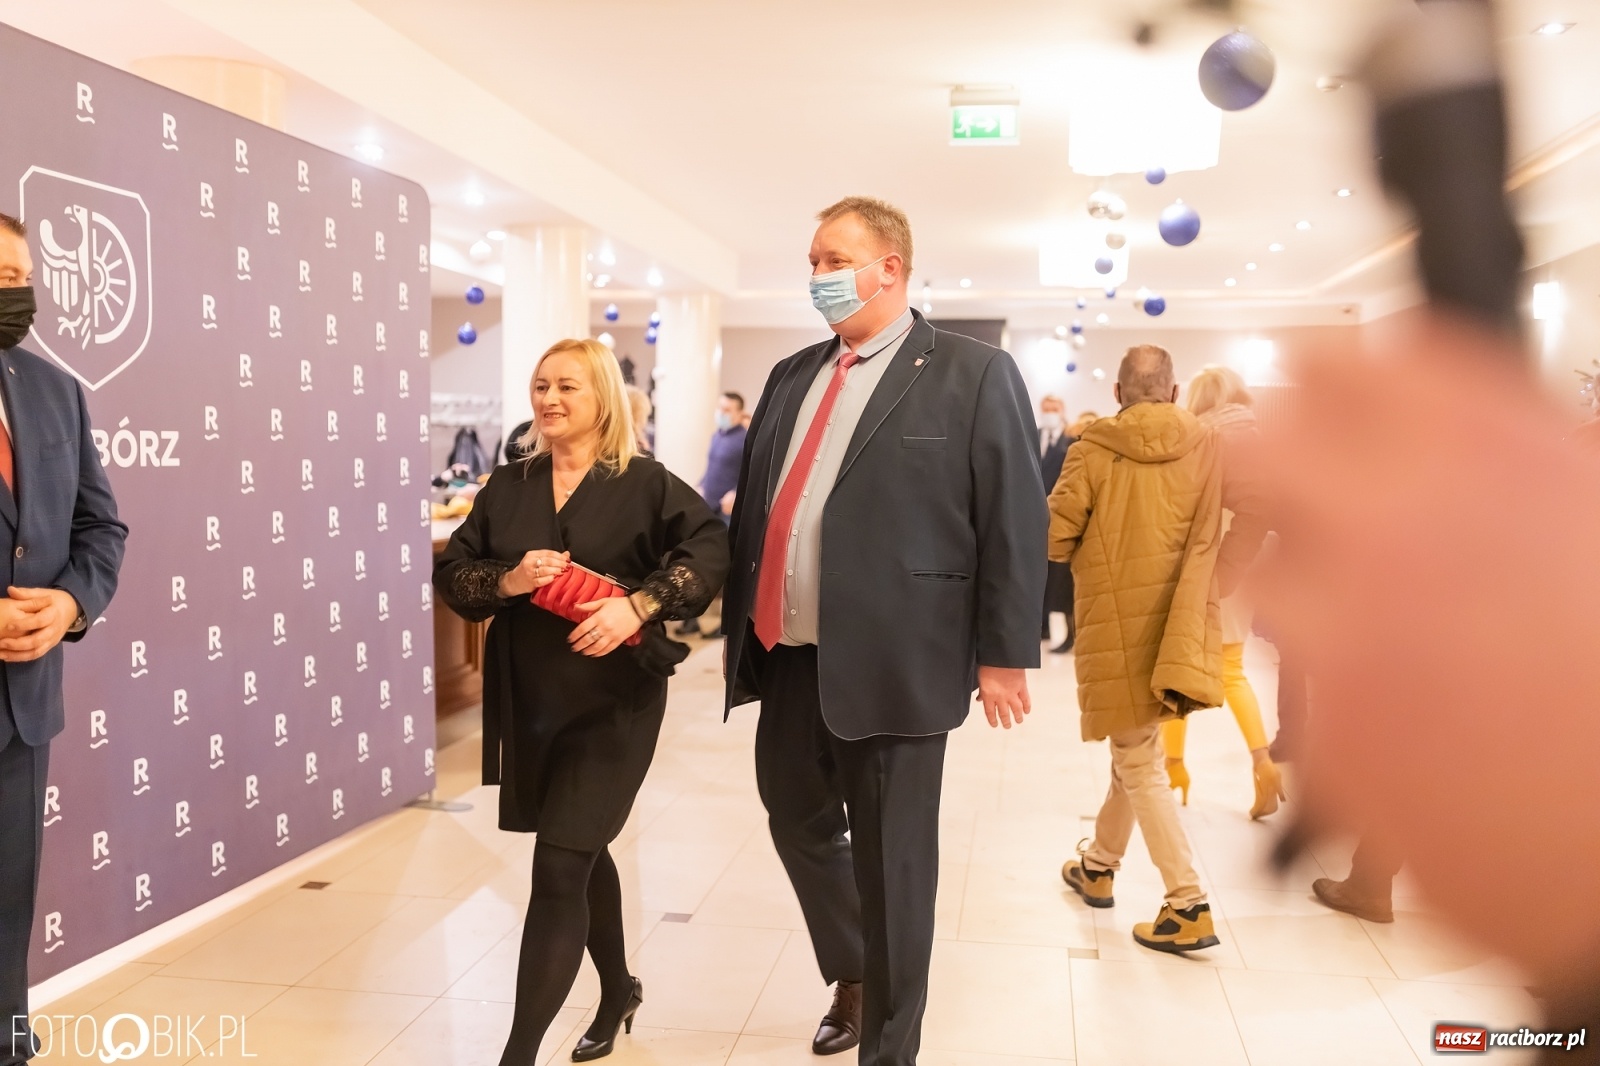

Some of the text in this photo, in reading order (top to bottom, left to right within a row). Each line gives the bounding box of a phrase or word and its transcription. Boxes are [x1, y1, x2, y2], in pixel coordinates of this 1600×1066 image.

[76, 81, 94, 114] R
[162, 112, 178, 142] R
[235, 138, 248, 165] R
[297, 159, 309, 185] R
[200, 181, 214, 210] R
[352, 178, 361, 201] R
[267, 201, 280, 227] R
[398, 195, 407, 215] R
[325, 217, 336, 241] R
[375, 231, 385, 253] R
[237, 246, 250, 272] R
[418, 244, 428, 266] R
[299, 260, 311, 284] R
[352, 271, 363, 294] R
[399, 282, 408, 303] R
[202, 294, 217, 321] R
[269, 305, 281, 330] R
[326, 314, 337, 337] R
[376, 322, 385, 344] R
[419, 330, 428, 350] R
[239, 353, 252, 379] R
[300, 359, 312, 383] R
[353, 364, 364, 387] R
[399, 370, 409, 391] R
[204, 405, 219, 431] R
[270, 408, 283, 432] R
[327, 410, 338, 433] R
[376, 412, 386, 434] R
[419, 414, 429, 435] R
[241, 460, 254, 485] R
[301, 458, 313, 482] R
[354, 457, 365, 480] R
[400, 457, 409, 478] R
[328, 506, 340, 529] R
[377, 502, 388, 524] R
[420, 498, 430, 520] R
[206, 515, 220, 541] R
[272, 510, 284, 535] R
[355, 550, 366, 573] R
[400, 543, 411, 565] R
[242, 565, 256, 591] R
[303, 557, 315, 581] R
[171, 575, 187, 602] R
[421, 582, 431, 604] R
[329, 601, 341, 624] R
[378, 591, 389, 613] R
[273, 612, 286, 637] R
[208, 625, 222, 651] R
[402, 629, 412, 651] R
[131, 640, 147, 668] R
[356, 641, 367, 664] R
[304, 655, 316, 679] R
[422, 665, 433, 687] R
[244, 670, 257, 696] R
[380, 679, 391, 702] R
[173, 688, 189, 716] R
[331, 695, 343, 719] R
[90, 709, 108, 739] R
[275, 713, 288, 738] R
[403, 714, 414, 736] R
[209, 733, 224, 760] R
[357, 731, 369, 755] R
[305, 751, 318, 776] R
[424, 748, 435, 769] R
[133, 757, 149, 786] R
[381, 766, 392, 789] R
[245, 774, 259, 800] R
[43, 785, 61, 816] R
[332, 788, 344, 812] R
[175, 800, 191, 828] R
[276, 812, 289, 838] R
[92, 830, 110, 860] R
[211, 840, 226, 868] R
[135, 873, 152, 902] R
[44, 911, 64, 943] R
